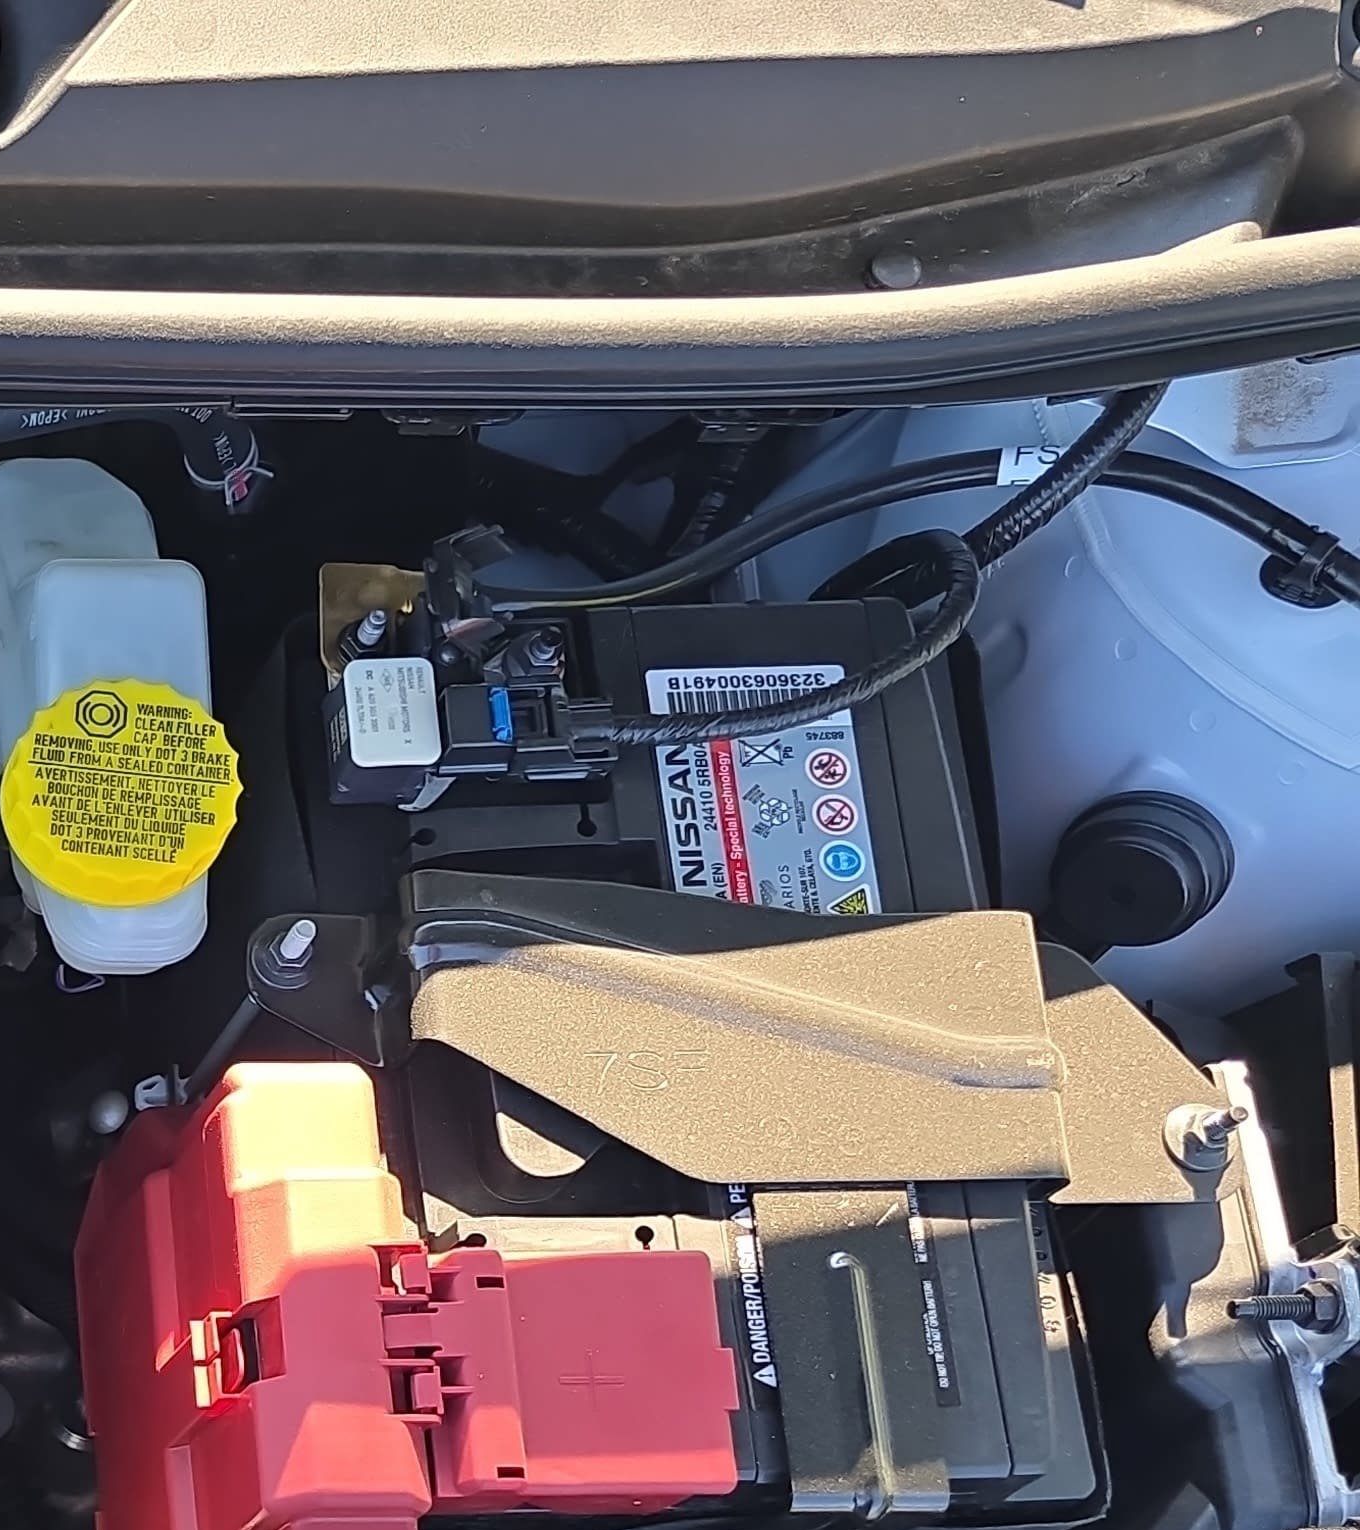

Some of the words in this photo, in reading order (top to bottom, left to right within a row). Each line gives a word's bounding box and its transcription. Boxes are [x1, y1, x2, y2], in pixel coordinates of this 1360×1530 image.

[667, 671, 827, 691] 323606300491B
[136, 703, 193, 720] WARNING:
[135, 717, 174, 733] CLEAN
[175, 721, 217, 737] FILLER
[98, 740, 120, 755] USE
[122, 743, 154, 759] ONLY
[155, 746, 179, 761] DOT
[180, 749, 188, 762] 3
[191, 751, 231, 768] BRAKE
[133, 731, 158, 745] CAP
[163, 733, 207, 751] BEFORE
[782, 745, 795, 760] Pb
[32, 747, 66, 763] FLUID
[69, 752, 102, 767] FROM
[106, 757, 114, 768] A
[117, 758, 164, 774] SEALED
[138, 778, 199, 797] NETTOYER
[201, 785, 216, 799] LE
[717, 750, 735, 813] technology
[47, 782, 99, 799] BOUCHON
[102, 788, 117, 801] DE
[119, 790, 202, 811] REMPLISSAGE
[701, 788, 719, 832] 24410
[32, 795, 73, 811] AVANT
[76, 799, 91, 812] DE
[94, 801, 158, 820] L'ENLEVER
[164, 808, 216, 826] UTILISER
[51, 809, 121, 828] SEULEMENT
[124, 817, 139, 830] DU
[141, 819, 186, 836] LIQUIDE
[664, 742, 708, 888] NISSAN
[50, 823, 73, 837] DOT
[75, 826, 83, 838] 3
[86, 827, 156, 847] PROVENANT
[159, 834, 185, 850] D'UN
[730, 813, 743, 861] Special
[61, 839, 130, 858] CONTENANT
[132, 846, 177, 863] SCELLÉ
[734, 869, 750, 904] attery
[778, 864, 795, 910] ARIOS
[728, 1184, 746, 1204] PE
